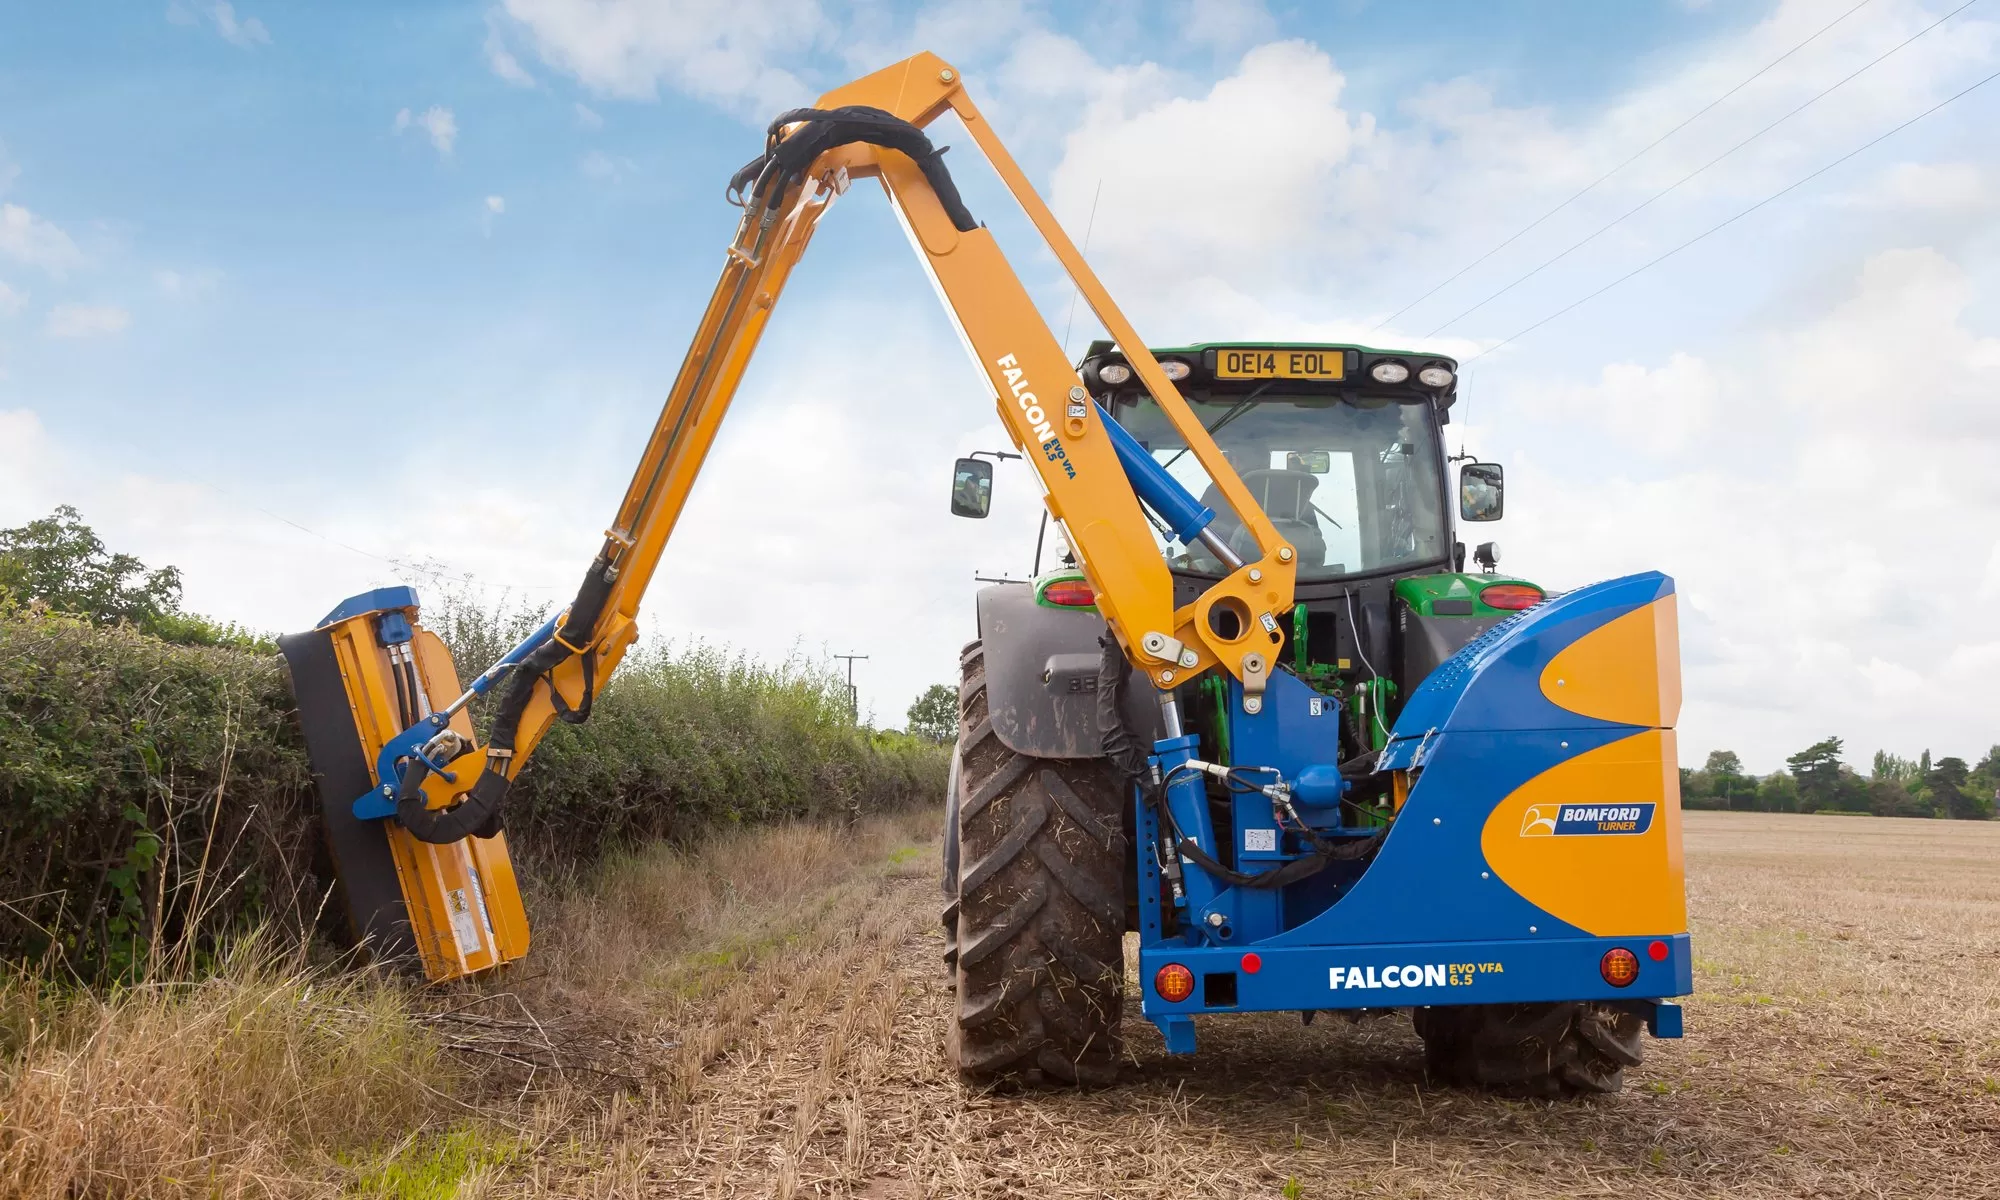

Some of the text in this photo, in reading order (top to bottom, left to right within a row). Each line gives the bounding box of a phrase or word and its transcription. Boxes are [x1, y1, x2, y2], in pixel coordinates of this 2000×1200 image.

[1227, 352, 1332, 375] OE14 EOL
[997, 352, 1056, 443] FALCON
[1042, 441, 1057, 463] 6.5
[1050, 437, 1077, 480] EVO VFA
[1563, 807, 1641, 822] BOMFORD
[1597, 821, 1636, 831] TURNER
[1329, 964, 1446, 990] FALCON
[1449, 962, 1504, 974] EVO VFA
[1449, 974, 1473, 986] 6.5
